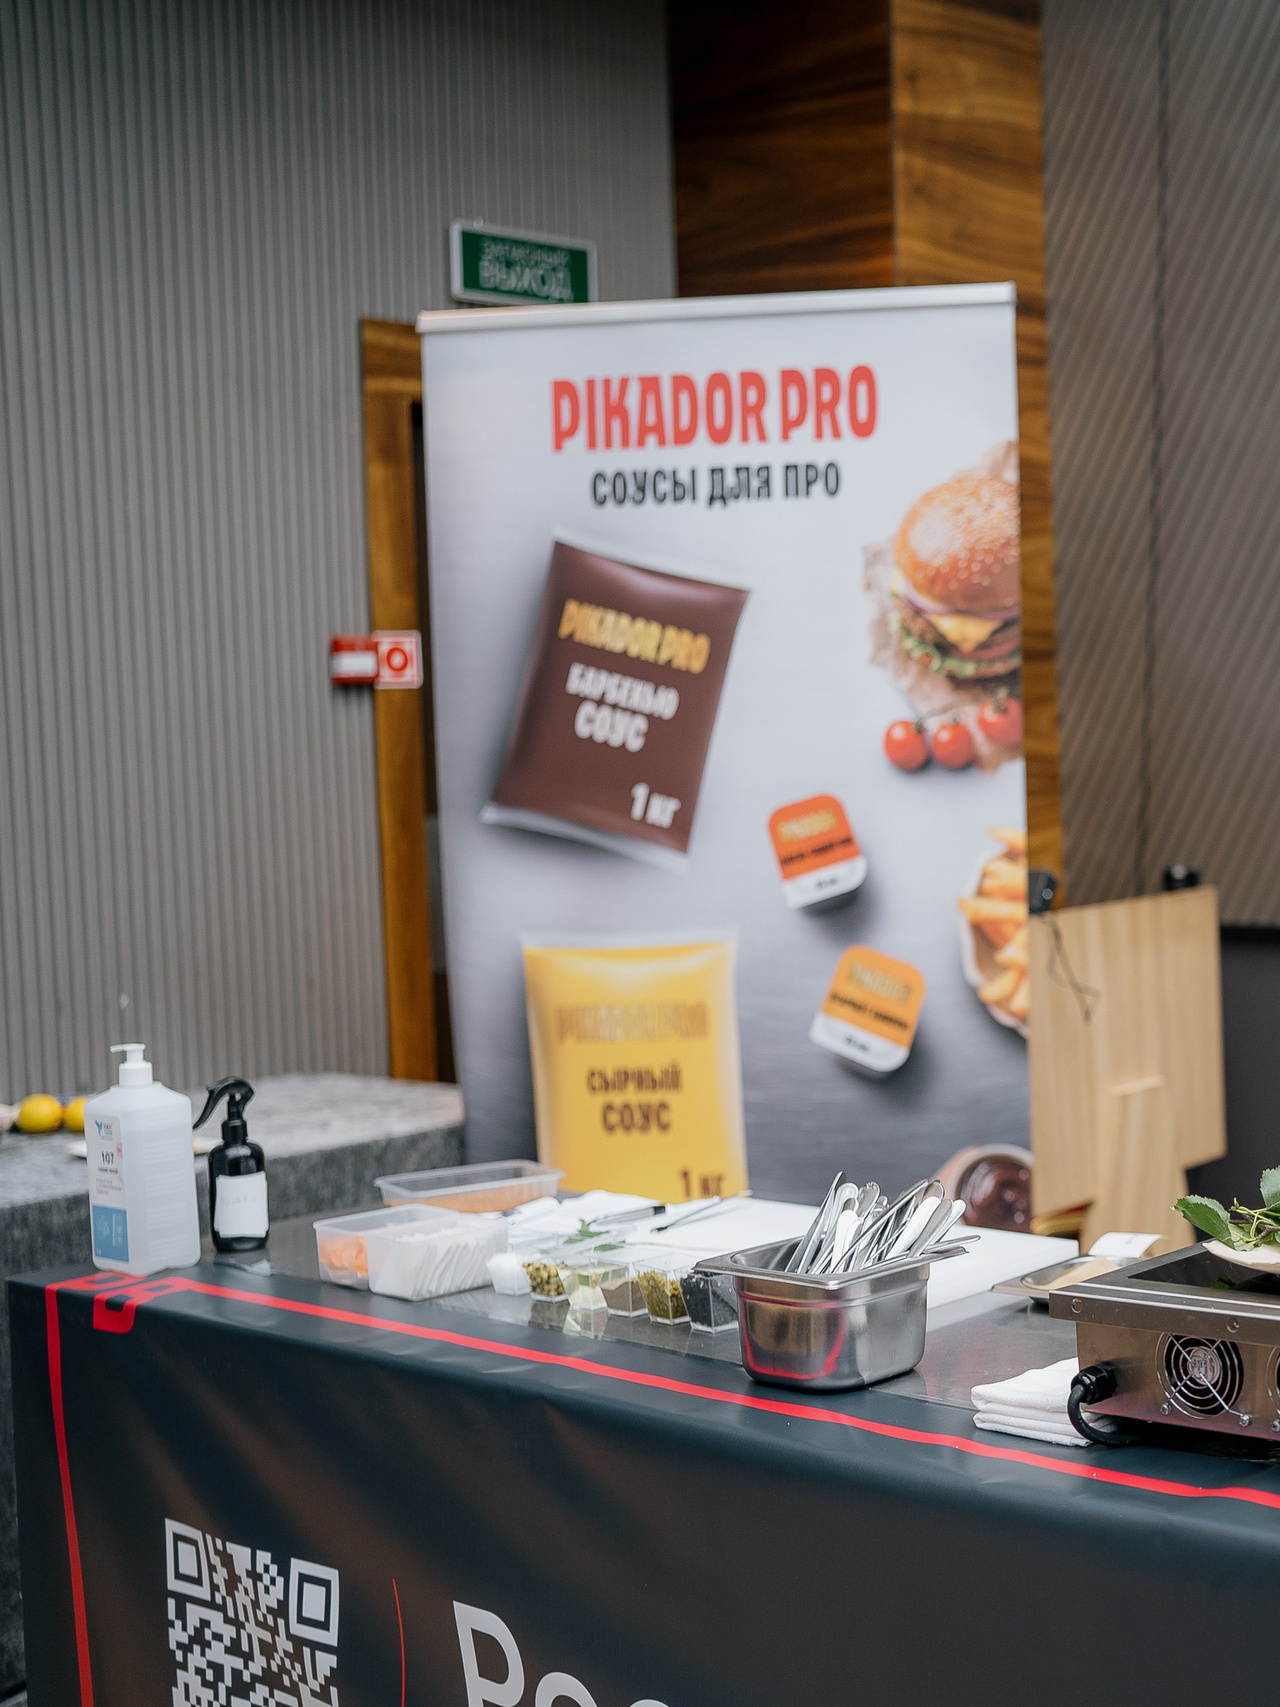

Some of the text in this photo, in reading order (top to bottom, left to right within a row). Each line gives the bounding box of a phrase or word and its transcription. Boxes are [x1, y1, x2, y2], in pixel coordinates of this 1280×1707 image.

[552, 365, 878, 451] PIKADOR PRO
[592, 462, 840, 507] СОУСЫ ДЛЯ ПРО
[559, 599, 711, 674] PIKADOR PRO
[574, 699, 650, 753] СОУС
[630, 781, 650, 821] 1
[587, 1061, 683, 1094] СЫРНЫЙ
[602, 1102, 672, 1134] СОУС
[101, 1151, 115, 1166] 107
